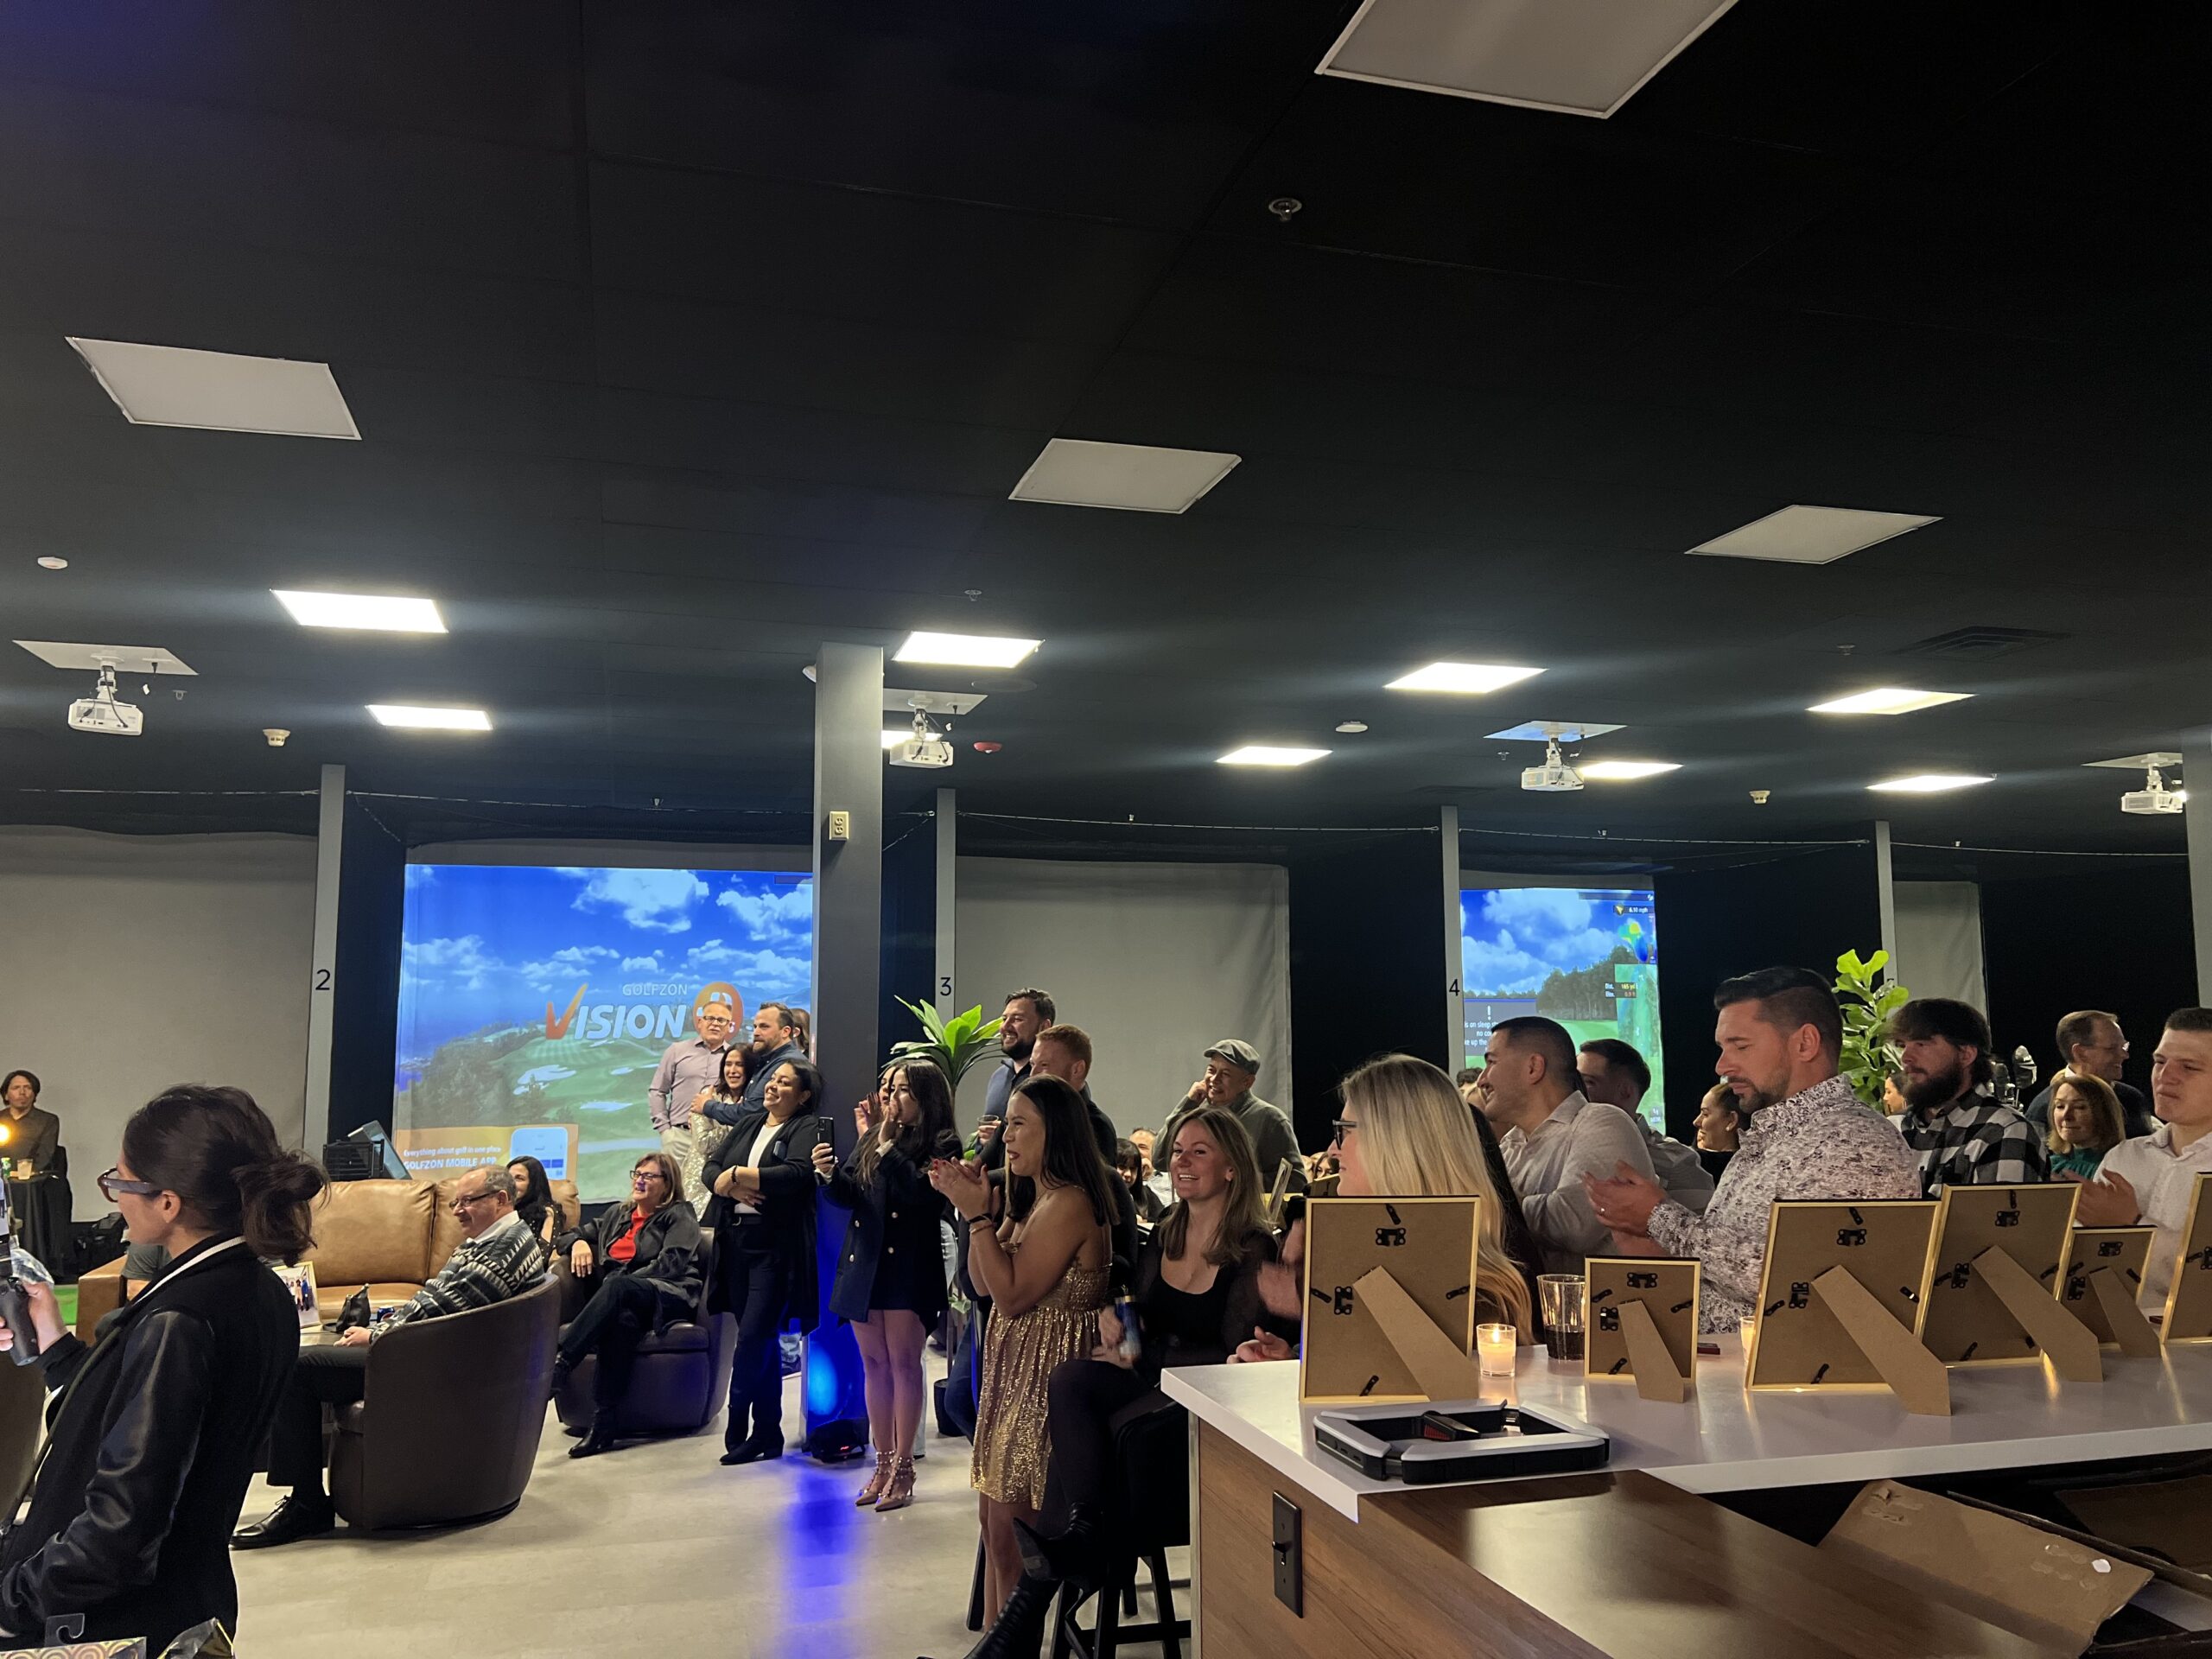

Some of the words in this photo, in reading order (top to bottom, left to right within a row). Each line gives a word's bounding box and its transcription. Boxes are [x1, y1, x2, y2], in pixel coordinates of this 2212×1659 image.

[315, 969, 331, 991] 2
[940, 976, 952, 996] 3
[1449, 978, 1460, 996] 4
[622, 983, 688, 996] GOLFZON
[545, 982, 687, 1040] VISION
[1478, 1020, 1491, 1029] sleep
[404, 1149, 435, 1158] Everything
[455, 1146, 467, 1155] golf
[404, 1160, 443, 1170] GOLFZON
[445, 1158, 478, 1167] MOBILE
[480, 1156, 497, 1166] APP
